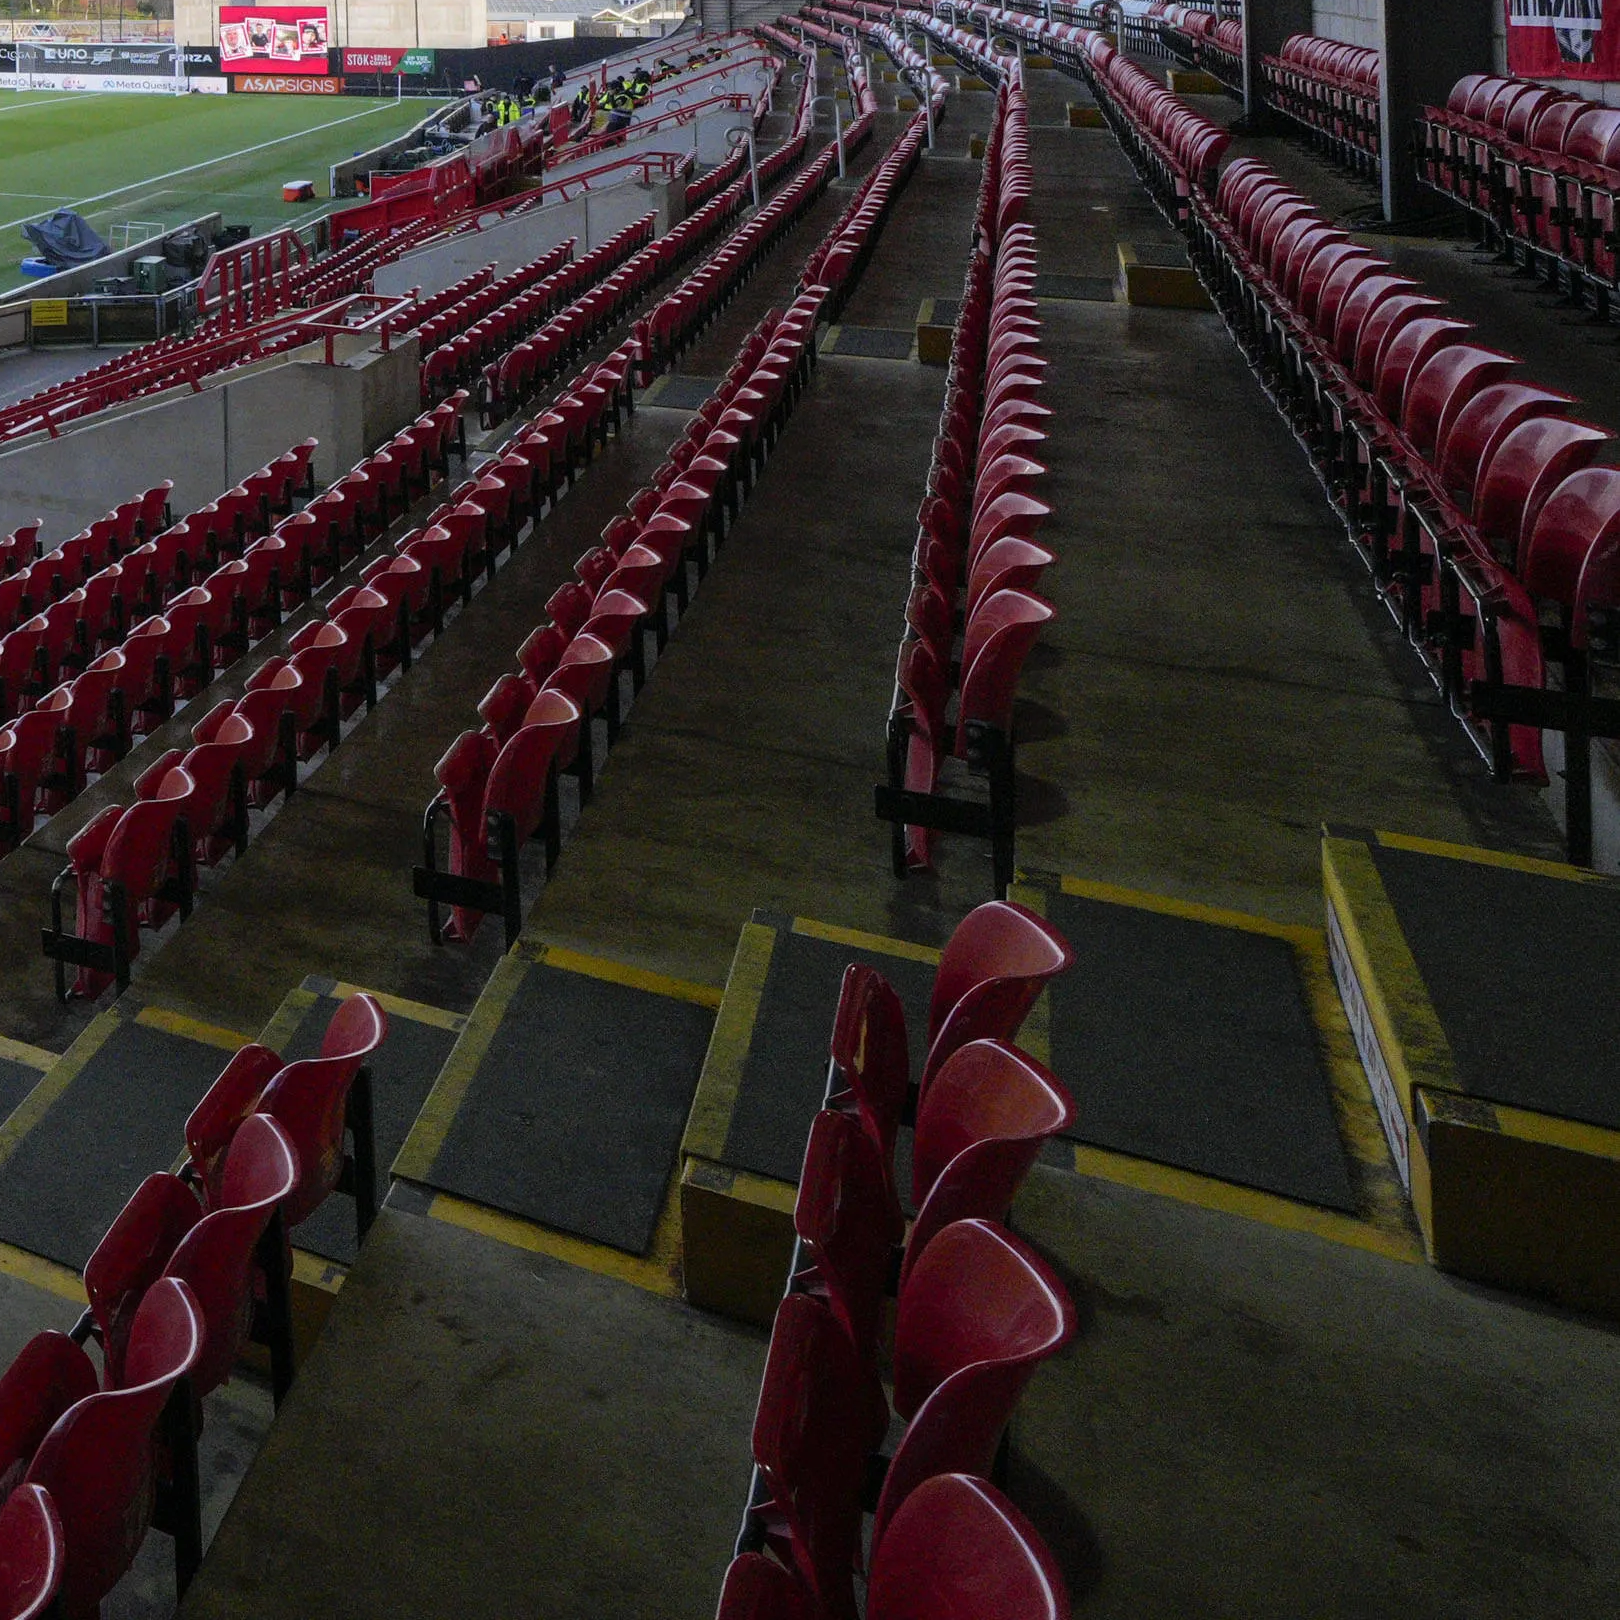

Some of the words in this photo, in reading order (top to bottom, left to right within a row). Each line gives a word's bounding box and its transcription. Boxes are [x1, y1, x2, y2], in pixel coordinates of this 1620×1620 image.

[168, 53, 213, 63] FORZA
[115, 81, 142, 90] Meta
[142, 80, 171, 91] Quest
